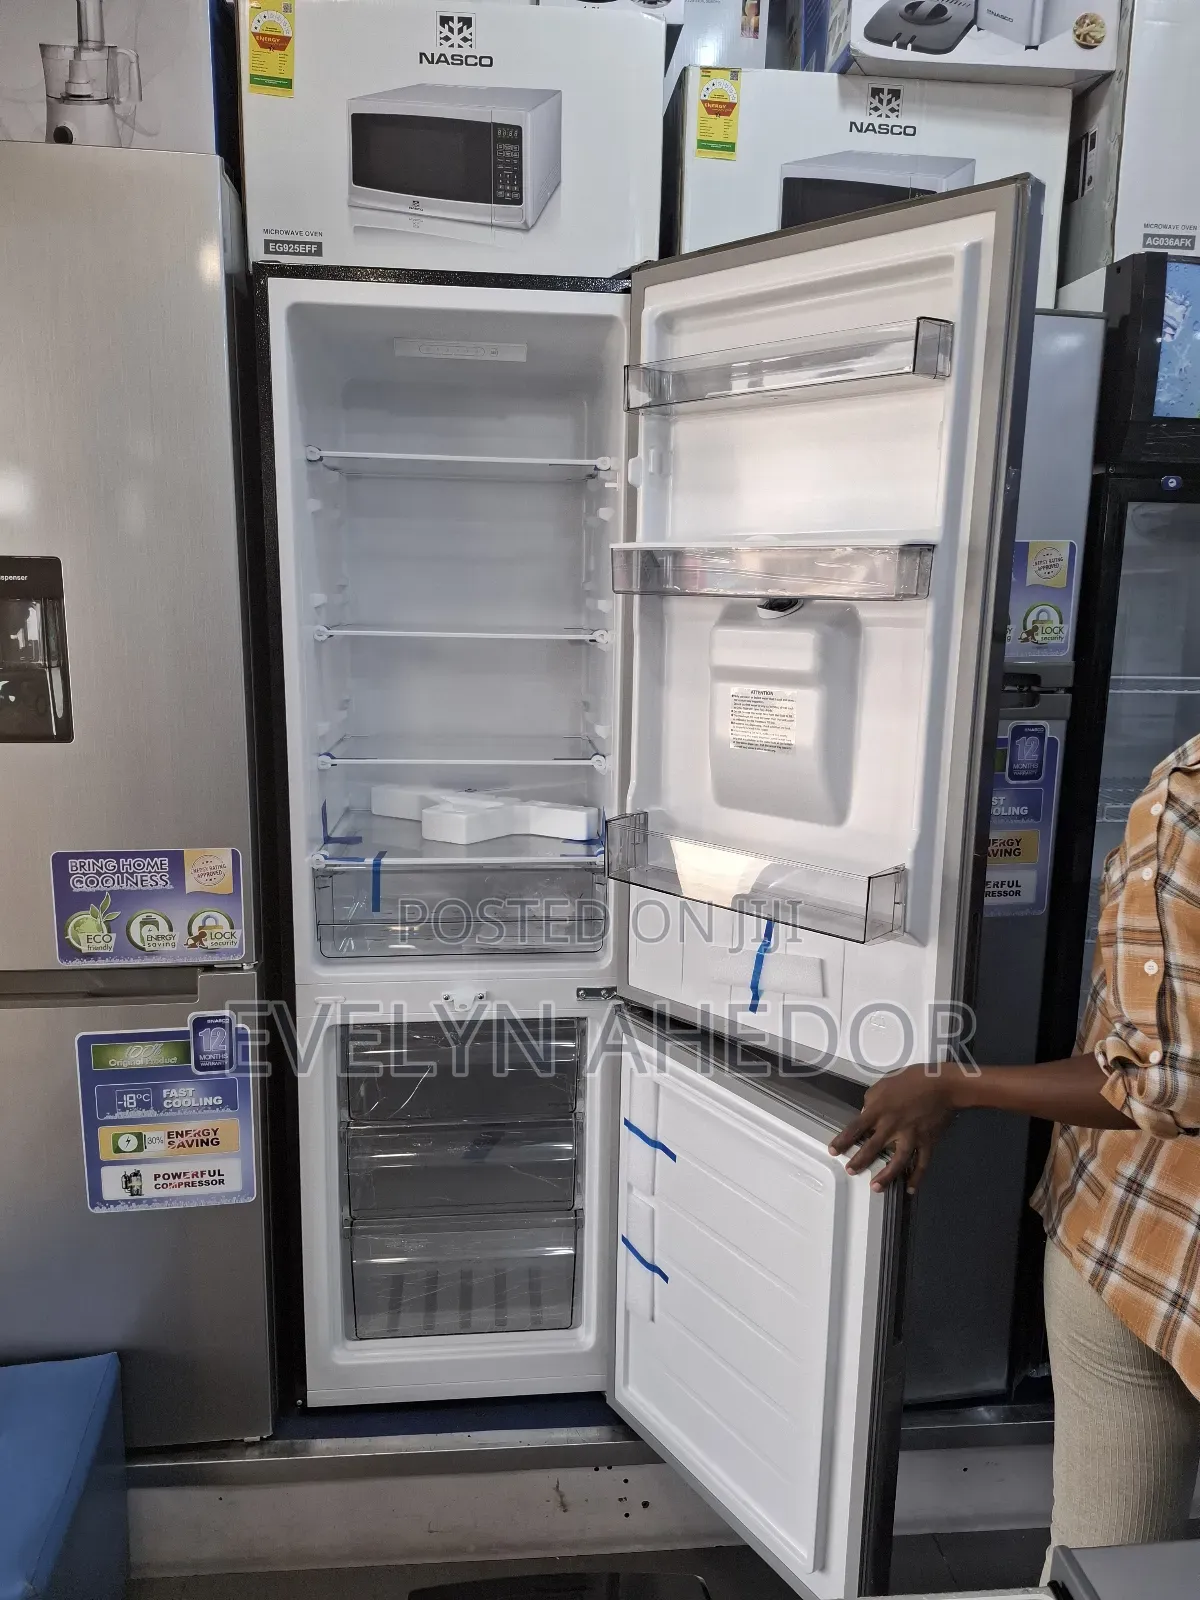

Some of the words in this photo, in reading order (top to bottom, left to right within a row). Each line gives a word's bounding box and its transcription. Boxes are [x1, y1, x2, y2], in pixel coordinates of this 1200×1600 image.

[255, 35, 281, 43] ENERGY
[419, 52, 493, 67] NASCO
[849, 121, 917, 136] NASCO
[263, 228, 304, 237] MICROWAVE
[1146, 236, 1192, 247] AG036AFK
[269, 242, 318, 253] EG925EFF
[1041, 626, 1065, 635] LOCK
[1015, 736, 1040, 761] 12
[991, 796, 1006, 806] ST
[990, 806, 1029, 816] OLING
[68, 858, 118, 874] BRING
[119, 857, 169, 873] HOME
[197, 869, 223, 878] APPROVED
[69, 873, 170, 890] COOLNESS
[985, 880, 1022, 889] ERFUL
[984, 890, 1022, 898] RESSOR
[86, 933, 113, 944] ECO
[146, 933, 177, 941] ENERGY
[210, 931, 237, 940] LOCK
[147, 940, 176, 948] saving
[210, 939, 238, 947] security
[198, 1027, 227, 1052] 12
[108, 1057, 144, 1068] Original
[144, 1056, 178, 1066] Product
[162, 1087, 196, 1099] FAST
[163, 1095, 223, 1109] COOLING
[167, 1127, 220, 1139] ENERGY
[147, 1136, 164, 1145] 30%
[167, 1137, 220, 1150] SAVING
[153, 1169, 225, 1181] POWERFUL
[154, 1179, 225, 1190] COMPRESSOR
